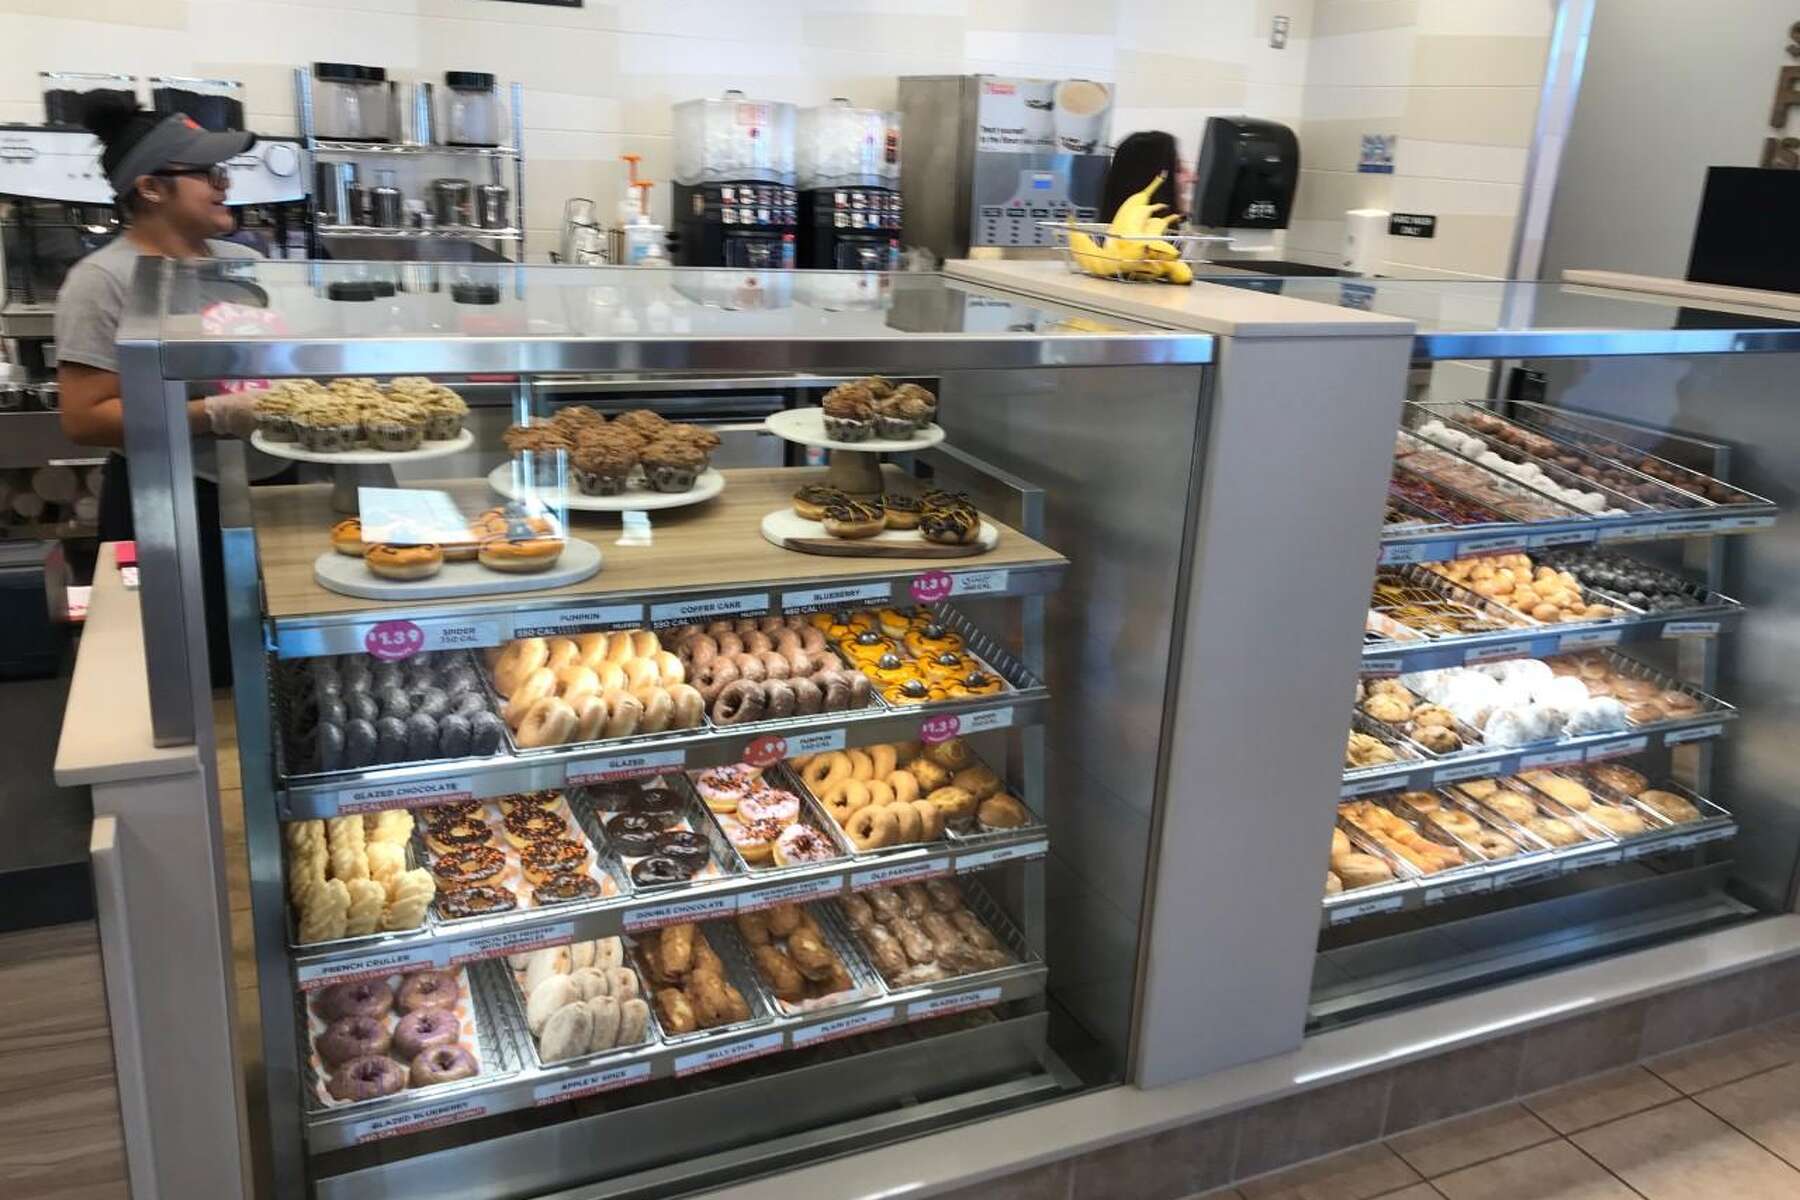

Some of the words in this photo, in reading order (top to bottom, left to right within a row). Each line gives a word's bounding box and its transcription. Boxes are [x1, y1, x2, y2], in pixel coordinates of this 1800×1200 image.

[813, 590, 861, 601] BLUEBERRY
[681, 604, 715, 614] COFFEE
[608, 758, 646, 768] GLAZED
[353, 789, 394, 801] GLAZED
[396, 783, 457, 795] CHOCOLATE
[366, 956, 411, 968] CRULLER
